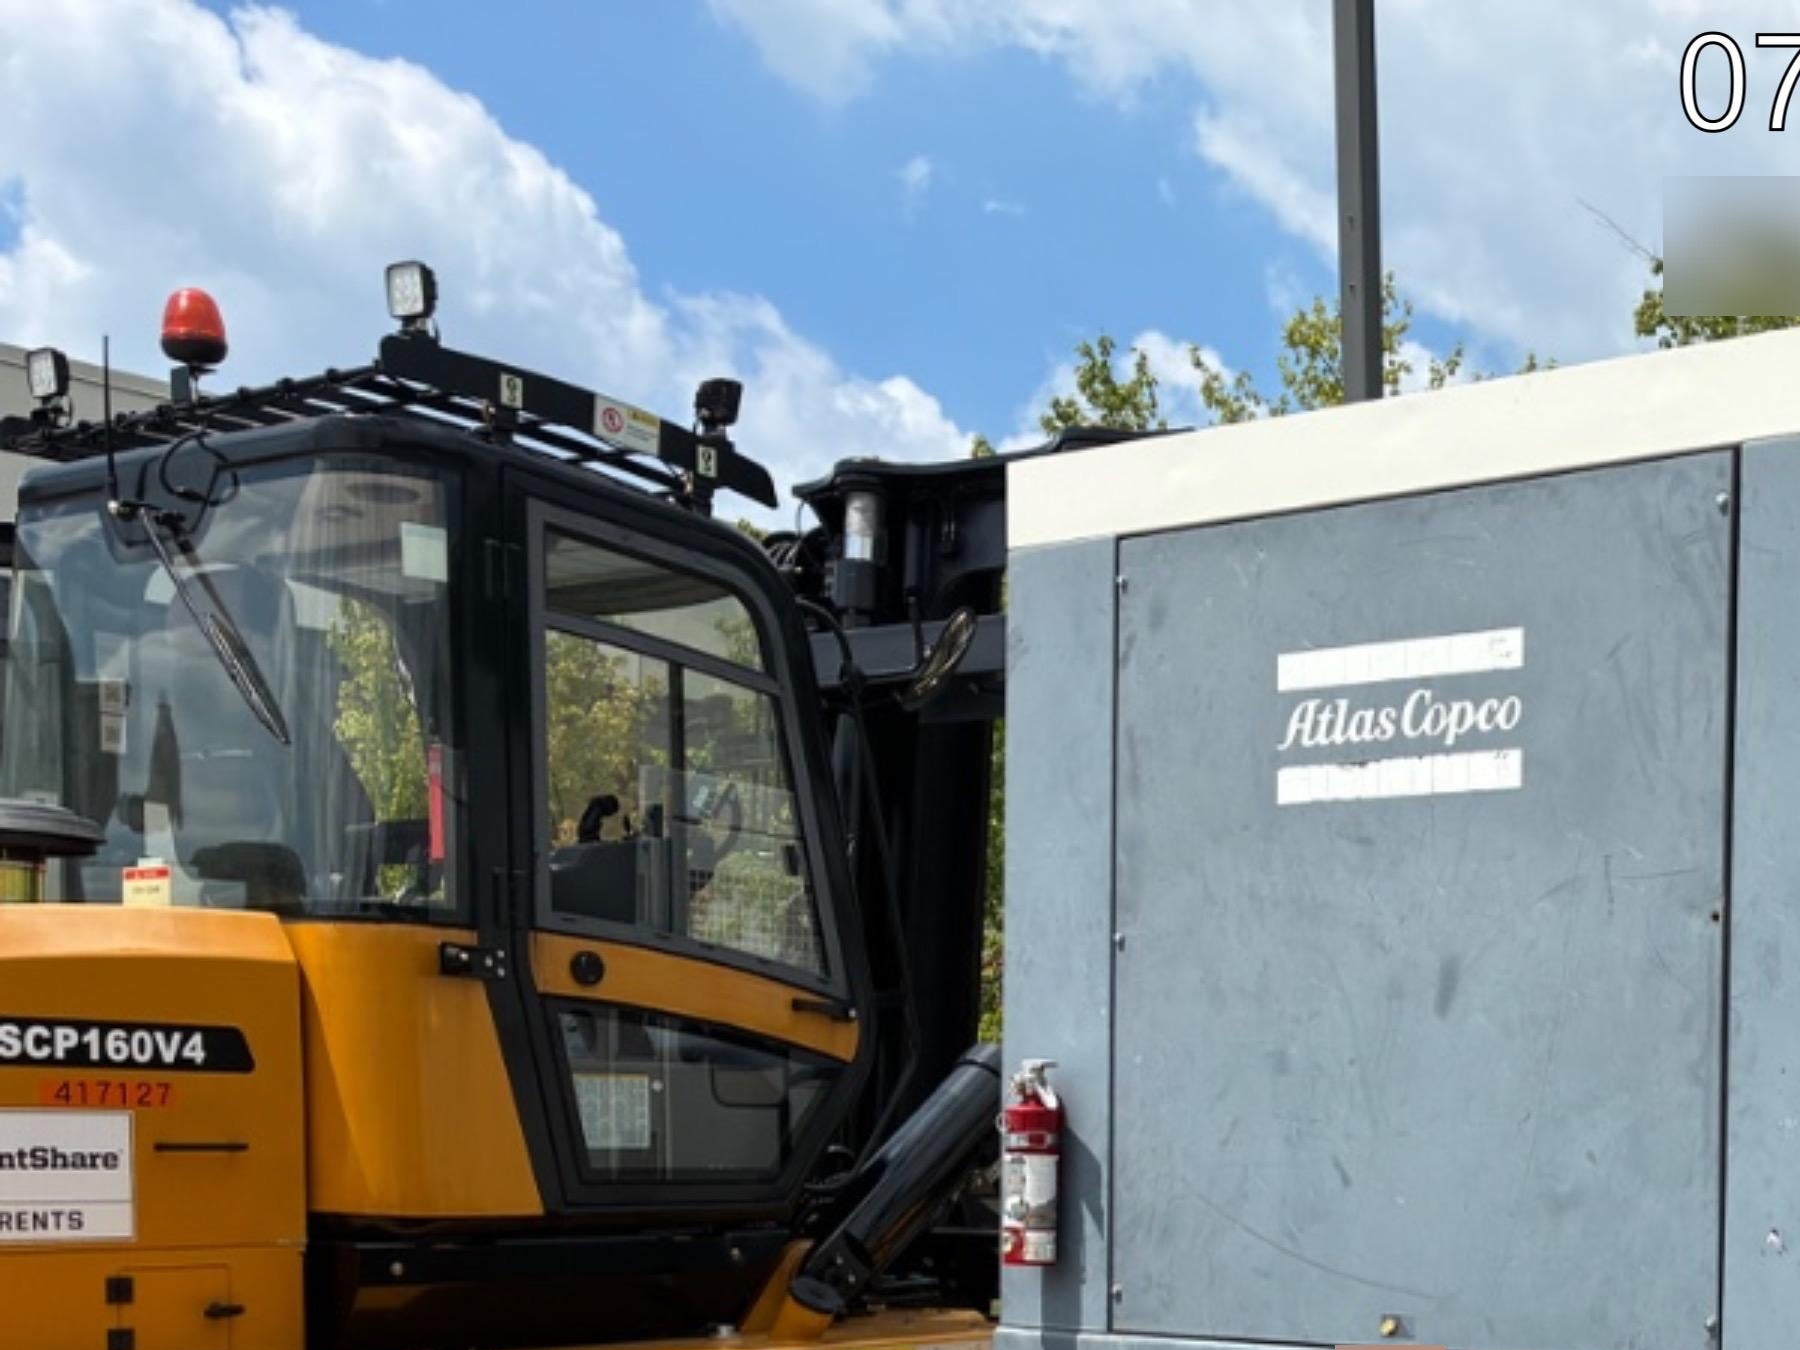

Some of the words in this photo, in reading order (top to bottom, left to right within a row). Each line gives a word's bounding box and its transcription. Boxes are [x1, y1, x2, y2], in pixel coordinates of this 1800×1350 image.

[1277, 698, 1397, 751] Atlas
[1400, 688, 1522, 746] Copco
[0, 1022, 206, 1065] SCP160V4
[54, 1080, 173, 1107] 417127
